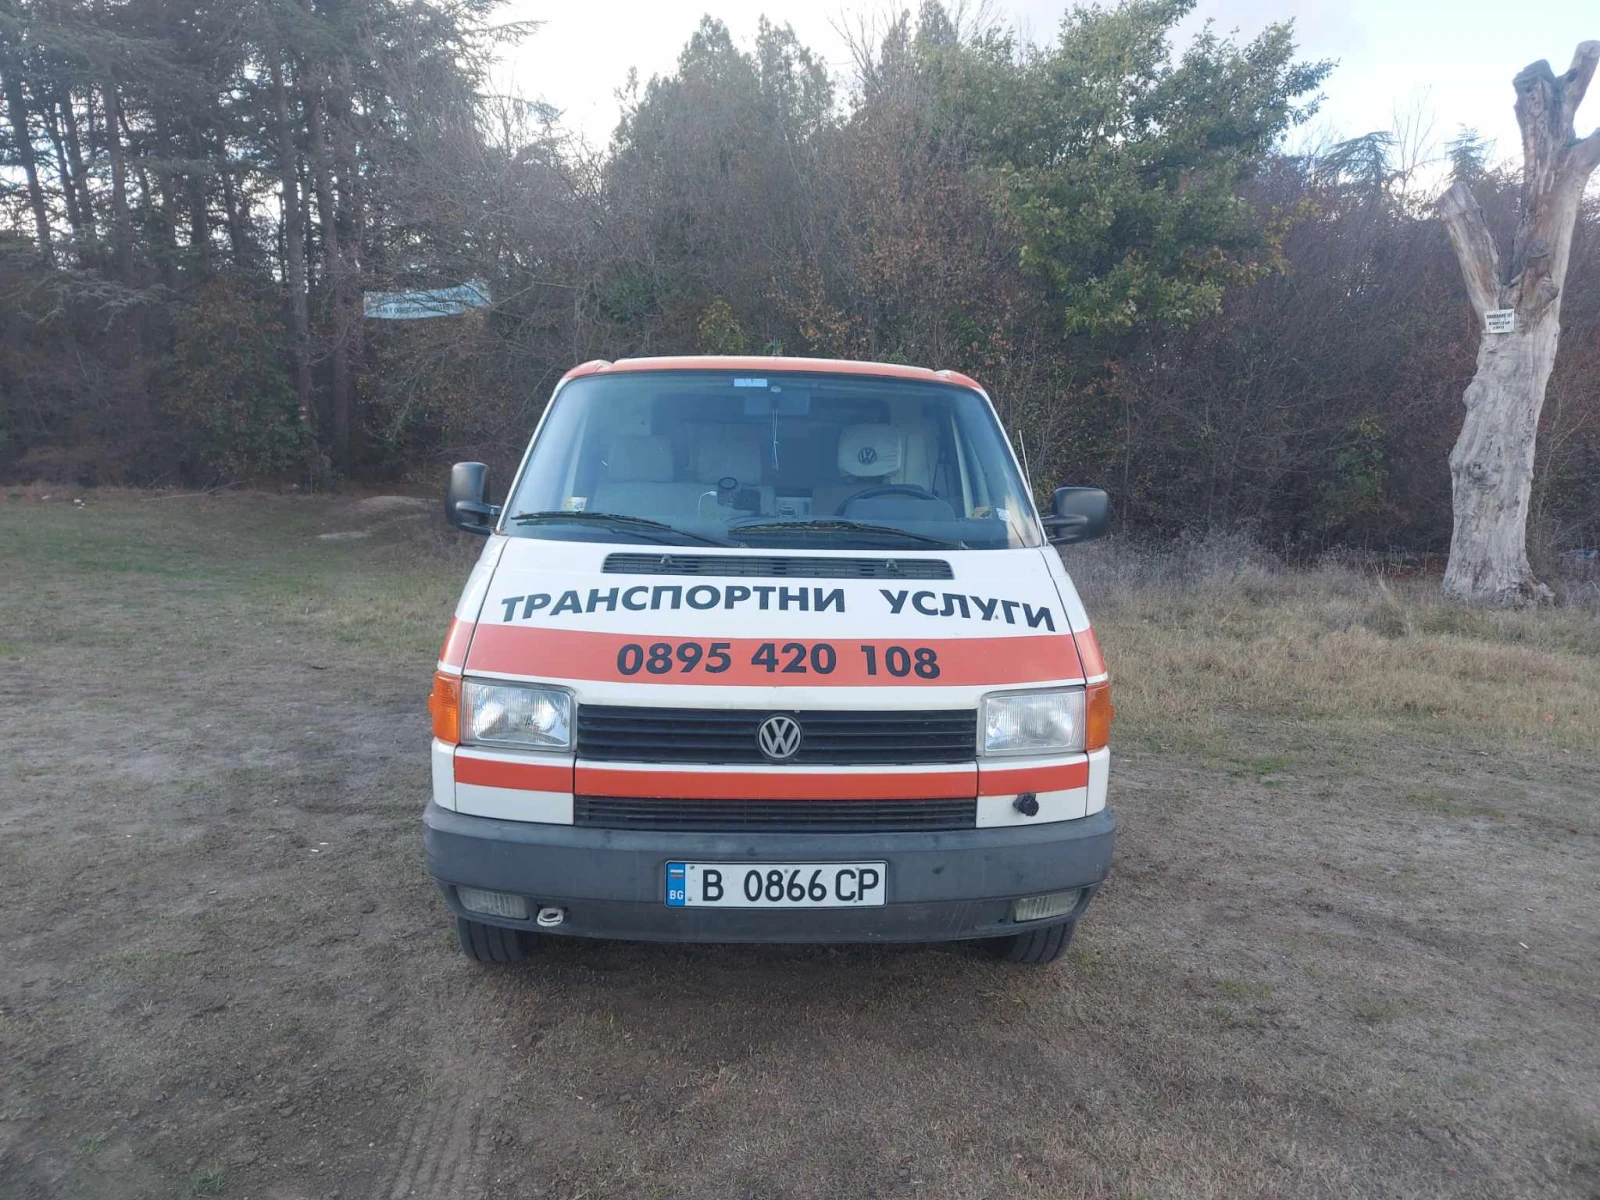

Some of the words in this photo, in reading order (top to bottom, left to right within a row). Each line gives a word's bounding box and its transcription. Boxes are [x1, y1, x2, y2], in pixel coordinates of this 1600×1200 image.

[501, 584, 846, 623] ТРАНСПОРТНИ
[879, 588, 1056, 633] УСЛУГИ
[616, 641, 732, 676] 0895
[750, 641, 837, 675] 420
[860, 644, 941, 680] 108
[759, 716, 801, 758] VW
[669, 889, 684, 900] BG
[743, 869, 828, 902] 0866
